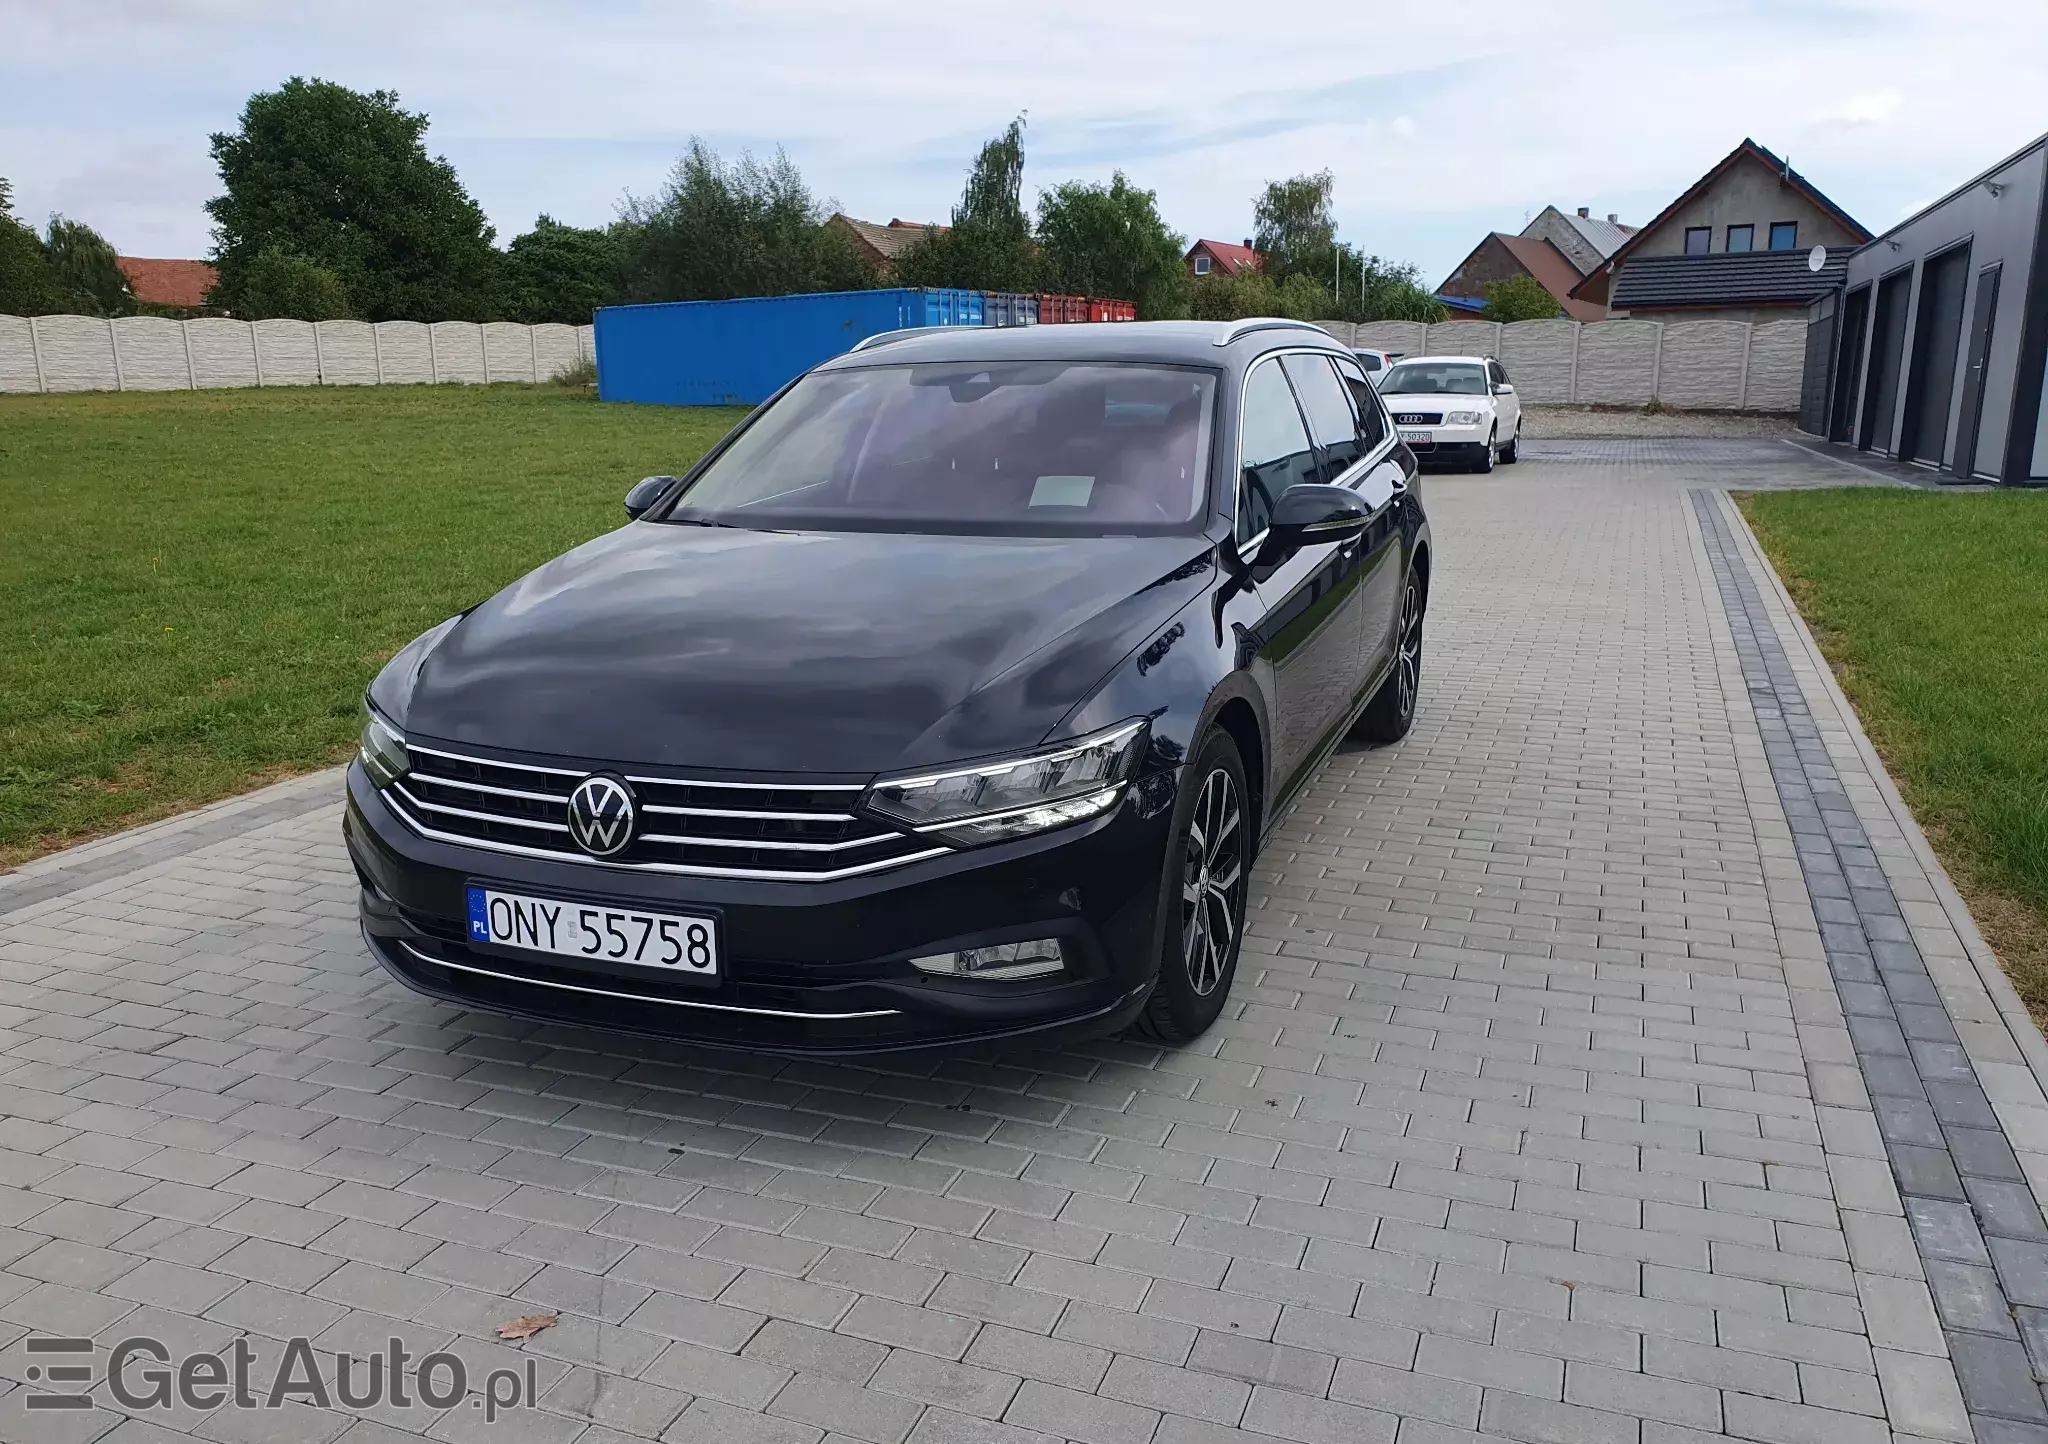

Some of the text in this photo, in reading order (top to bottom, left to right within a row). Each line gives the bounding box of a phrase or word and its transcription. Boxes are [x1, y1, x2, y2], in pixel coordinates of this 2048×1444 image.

[569, 779, 632, 854] VW
[473, 920, 487, 934] PL
[490, 898, 711, 968] ONY 55758
